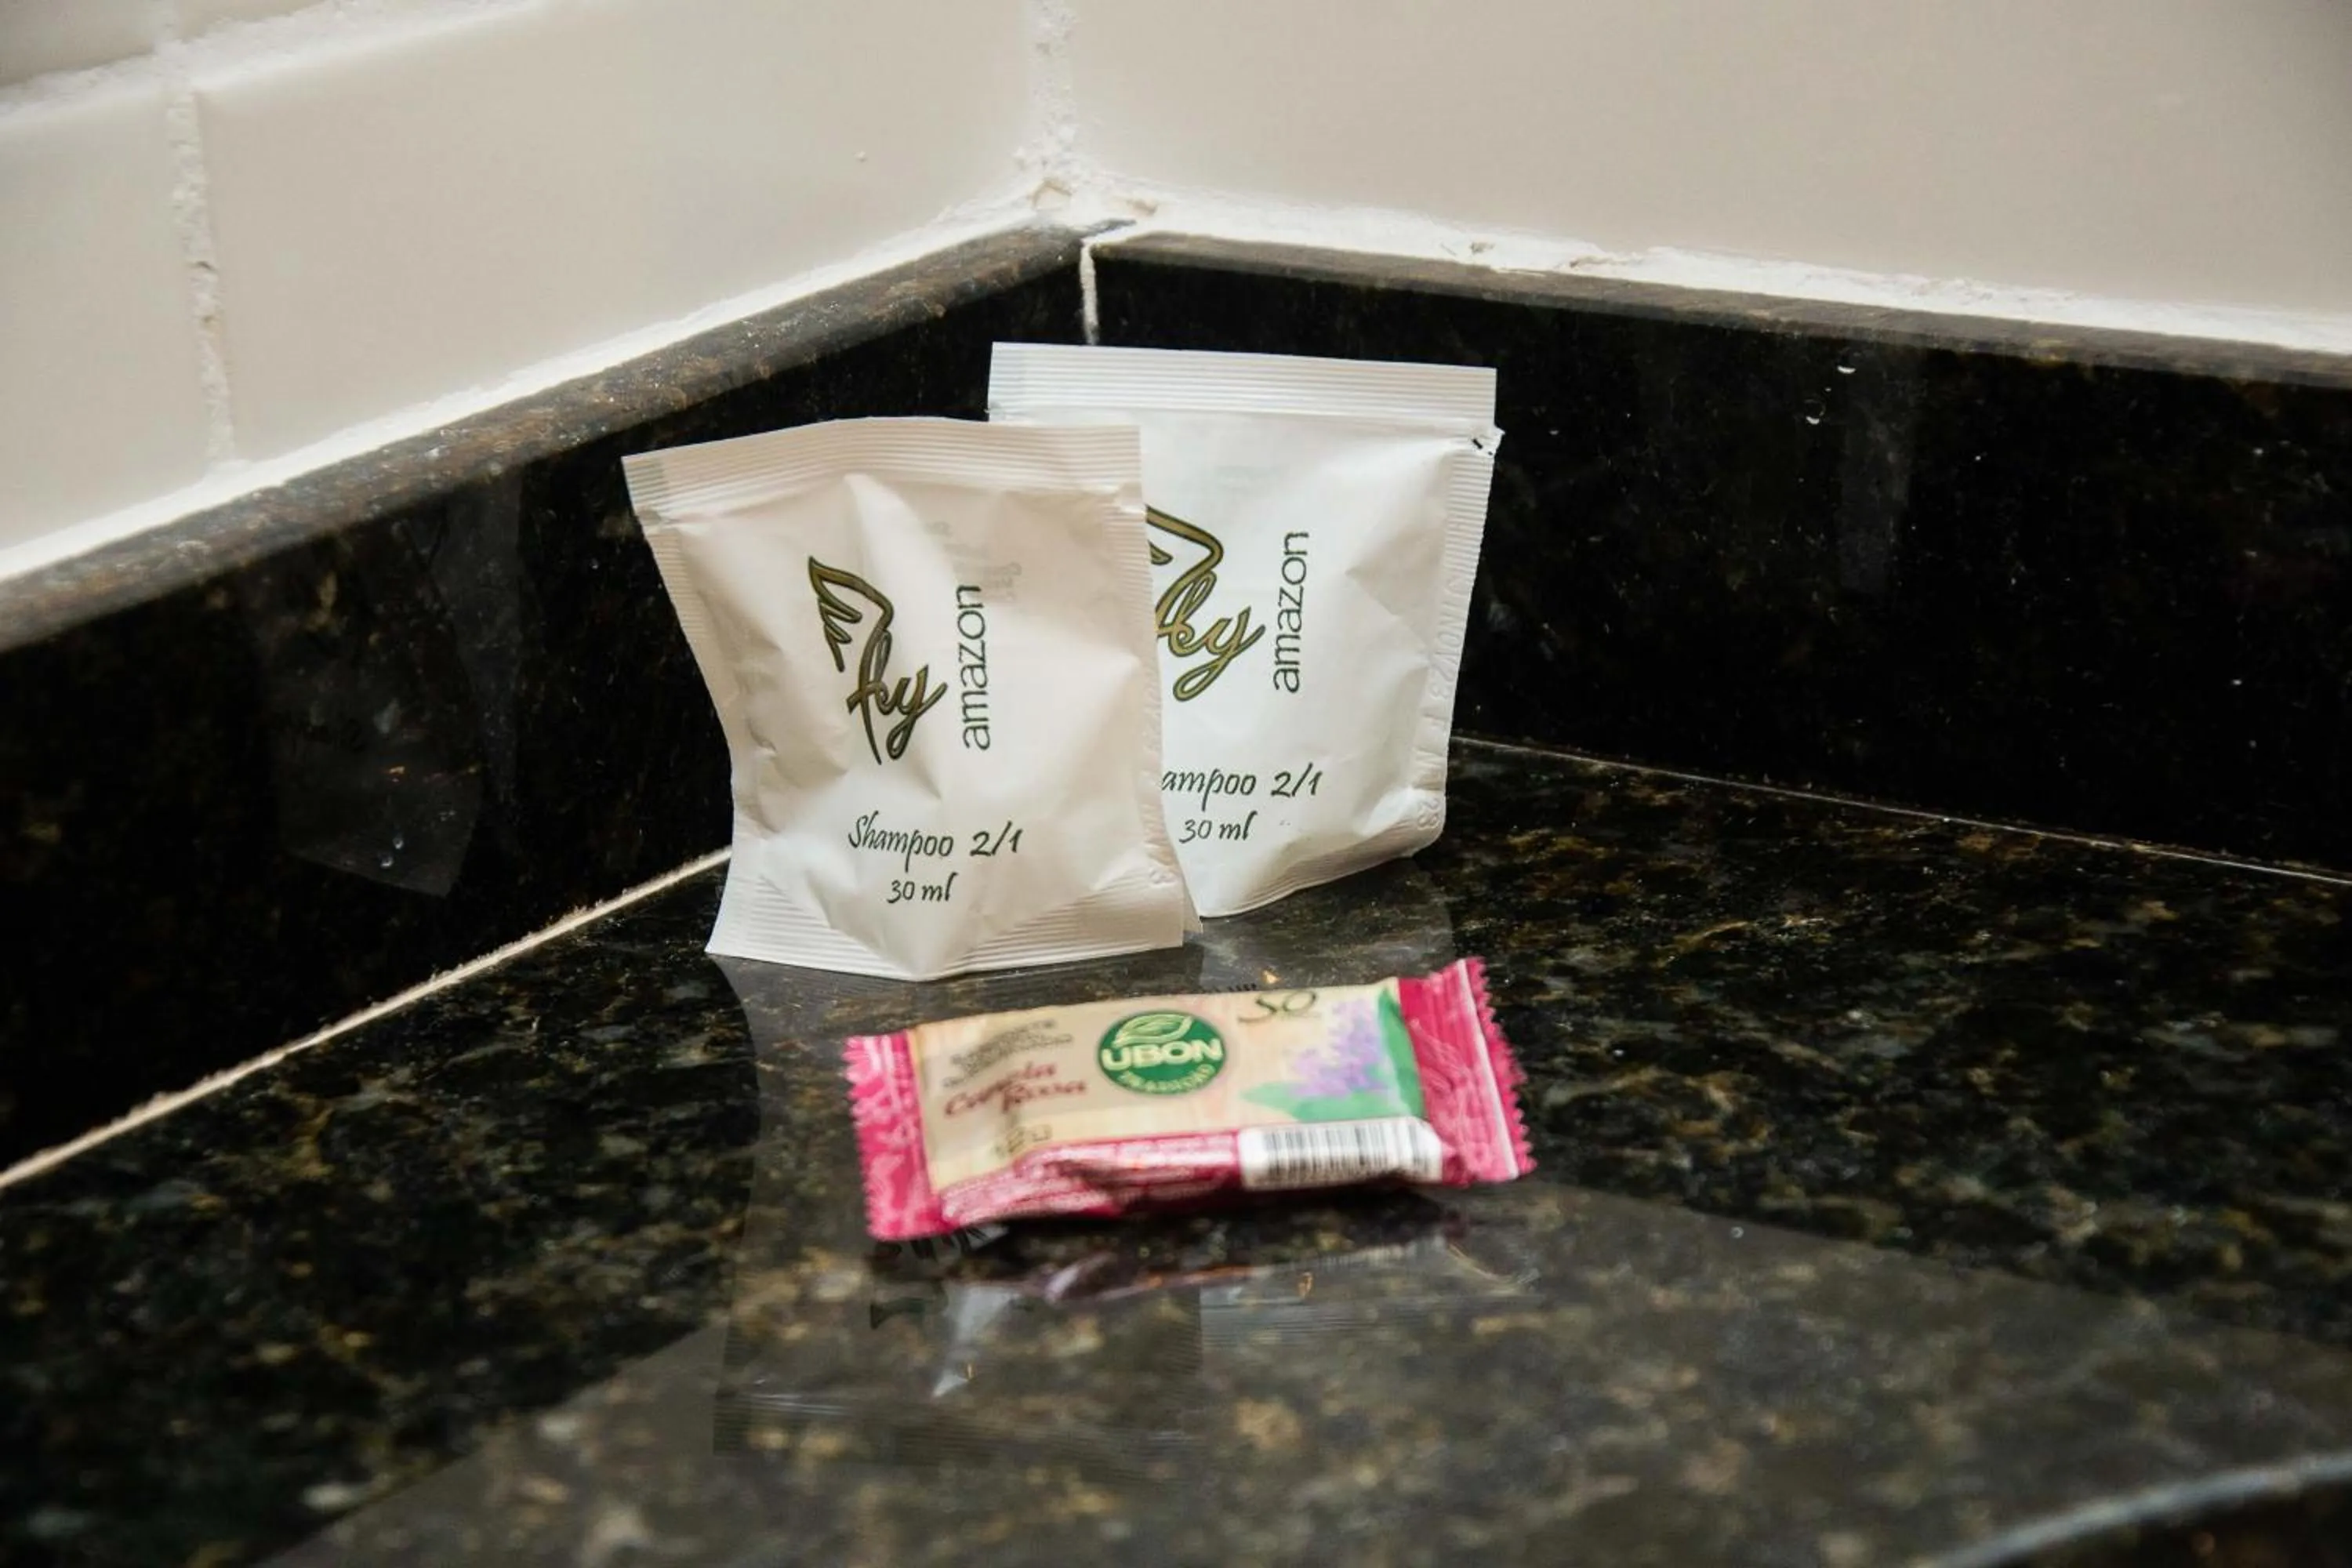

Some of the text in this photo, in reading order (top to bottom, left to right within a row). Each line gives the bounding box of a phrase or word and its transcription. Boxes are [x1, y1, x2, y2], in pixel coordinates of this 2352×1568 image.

[1272, 531, 1310, 695] amazon
[955, 584, 991, 752] amazon
[1162, 762, 1323, 811] ampoo 2/1
[848, 809, 1024, 873] Shampoo 2/1
[1178, 810, 1258, 844] 30 ml
[886, 871, 959, 905] 30 ml
[1101, 1037, 1224, 1072] UBON
